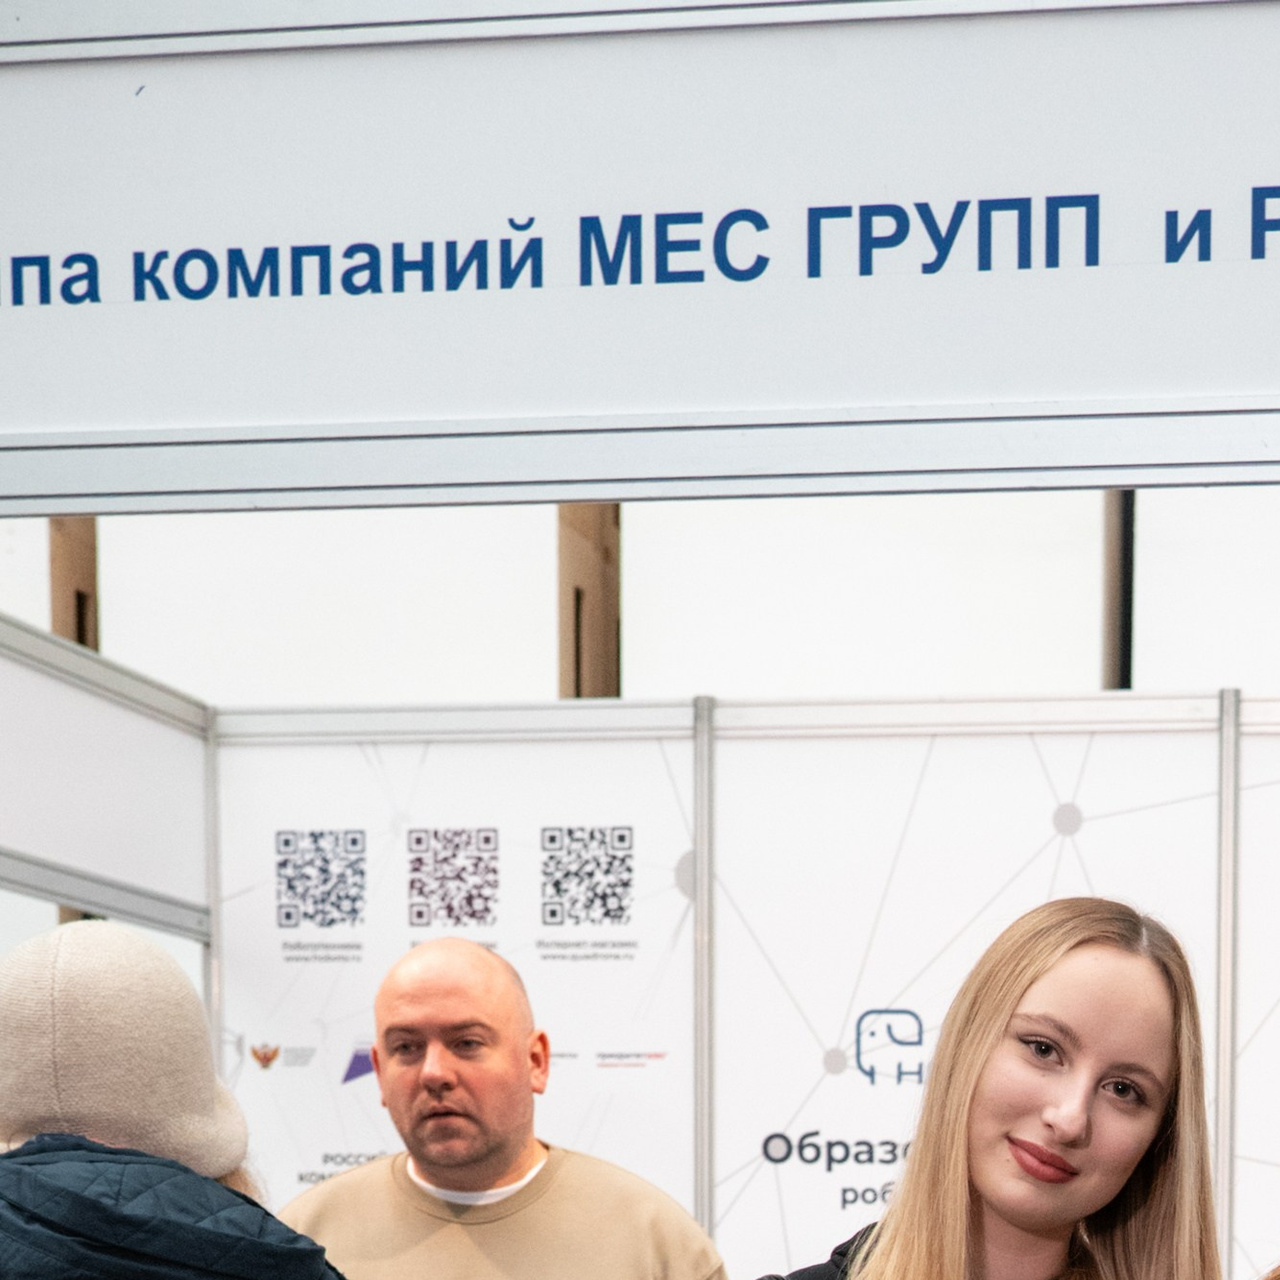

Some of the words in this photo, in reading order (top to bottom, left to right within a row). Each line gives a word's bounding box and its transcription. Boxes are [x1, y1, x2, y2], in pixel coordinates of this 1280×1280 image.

[8, 252, 101, 306] па
[133, 217, 542, 301] компаний
[580, 209, 769, 286] МЕС
[807, 194, 1099, 278] ГРУПП
[1165, 209, 1211, 263] и
[762, 1130, 912, 1172] Образ
